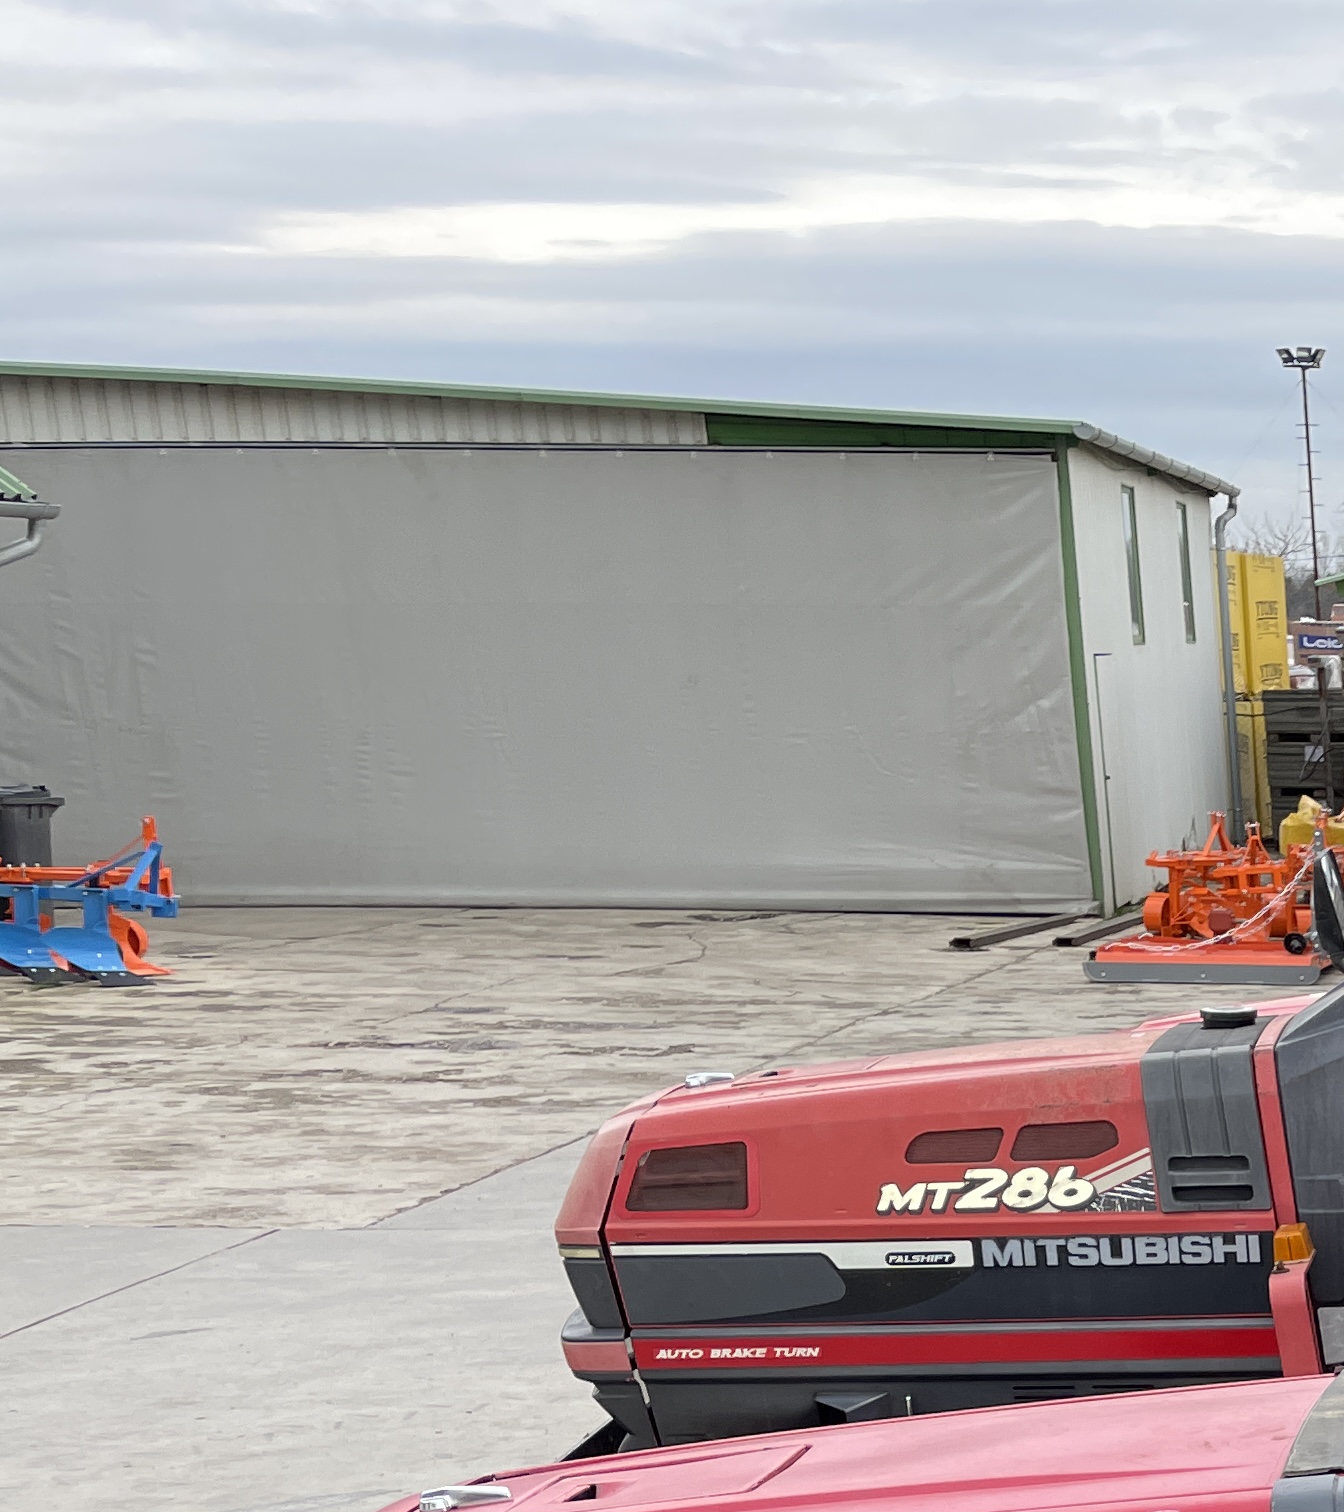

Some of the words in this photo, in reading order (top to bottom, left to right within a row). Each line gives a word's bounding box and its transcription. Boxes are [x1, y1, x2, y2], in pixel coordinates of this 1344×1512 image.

[876, 1166, 1096, 1215] MT286
[887, 1252, 954, 1265] PALSHIFT
[982, 1235, 1261, 1267] MITSUBISHI
[656, 1349, 704, 1359] AUTO
[710, 1348, 767, 1359] BRAKE
[774, 1347, 820, 1358] TURN
